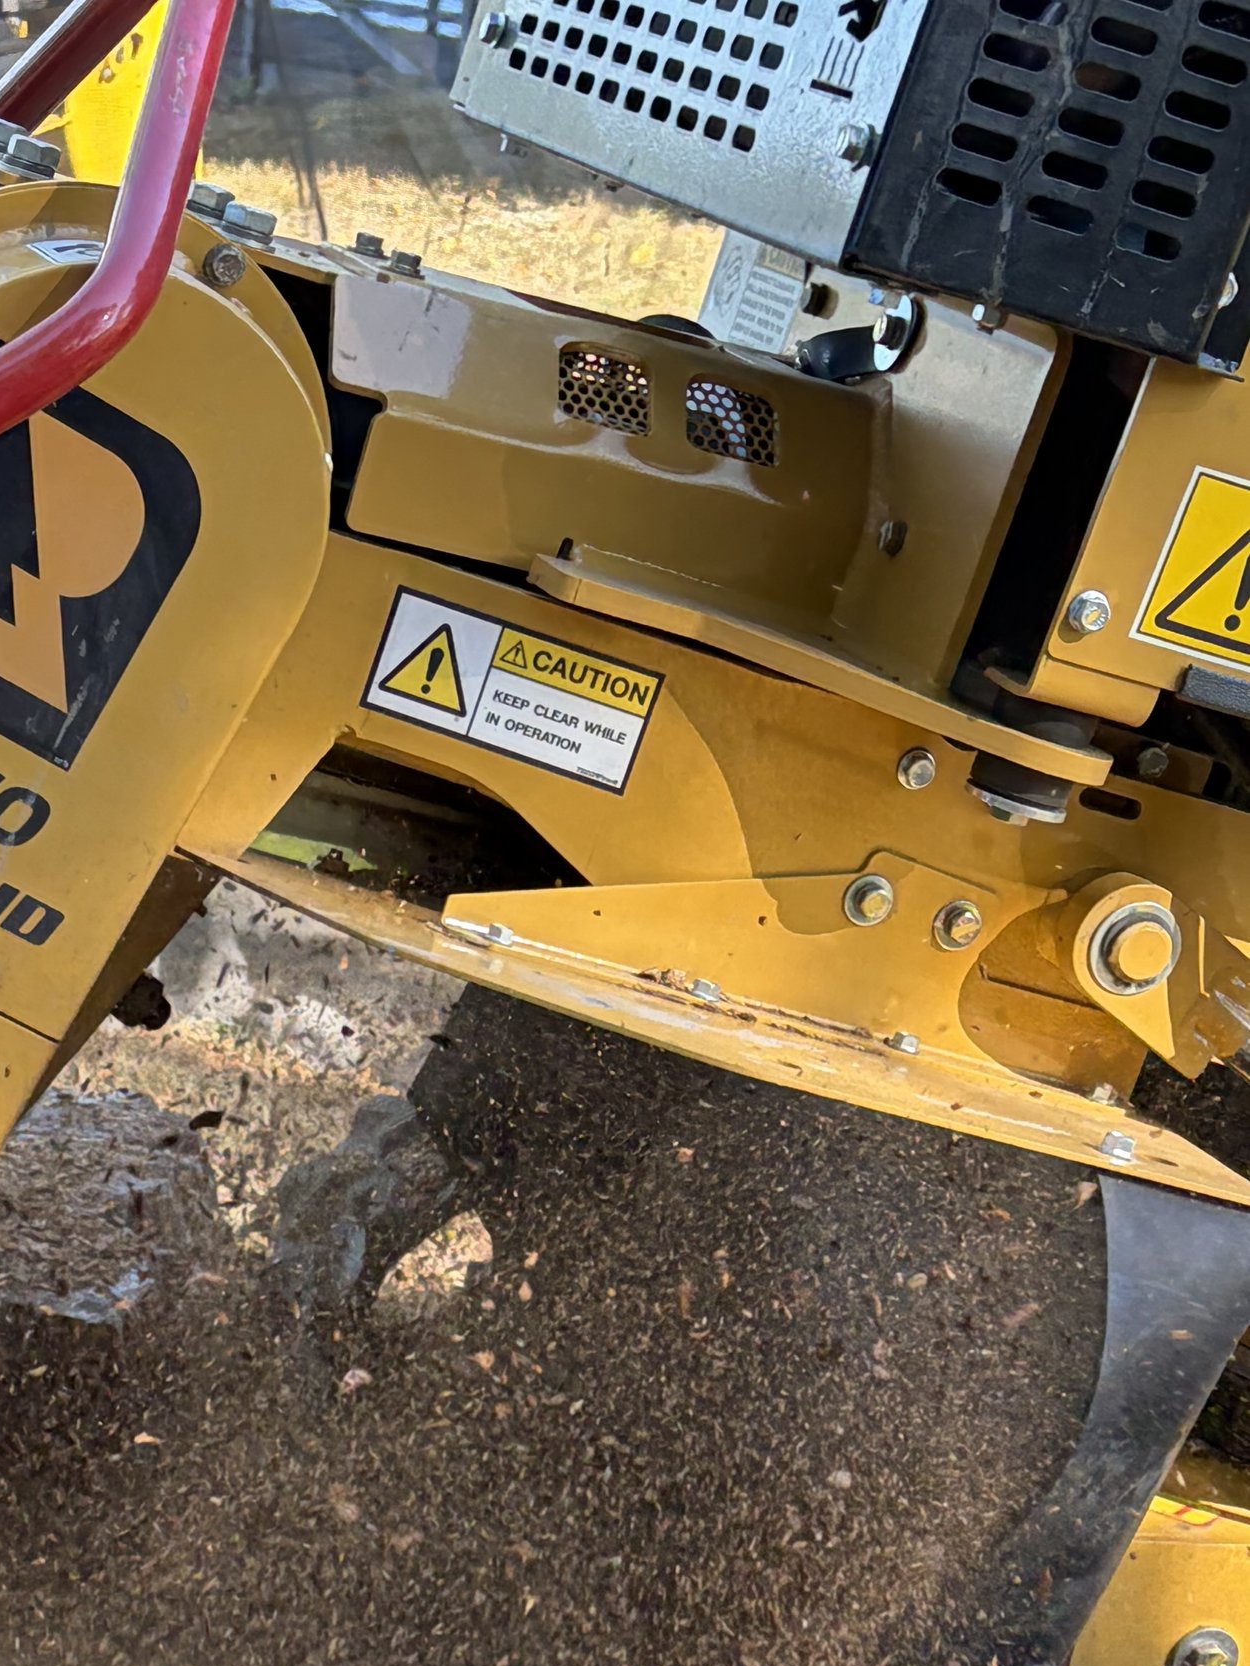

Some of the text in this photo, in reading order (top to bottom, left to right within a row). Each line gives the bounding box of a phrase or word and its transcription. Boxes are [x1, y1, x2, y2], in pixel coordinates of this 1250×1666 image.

[532, 650, 650, 706] CAUTION
[485, 710, 582, 754] IN OPERATION
[492, 689, 627, 745] KEEP CLEAR WHILE
